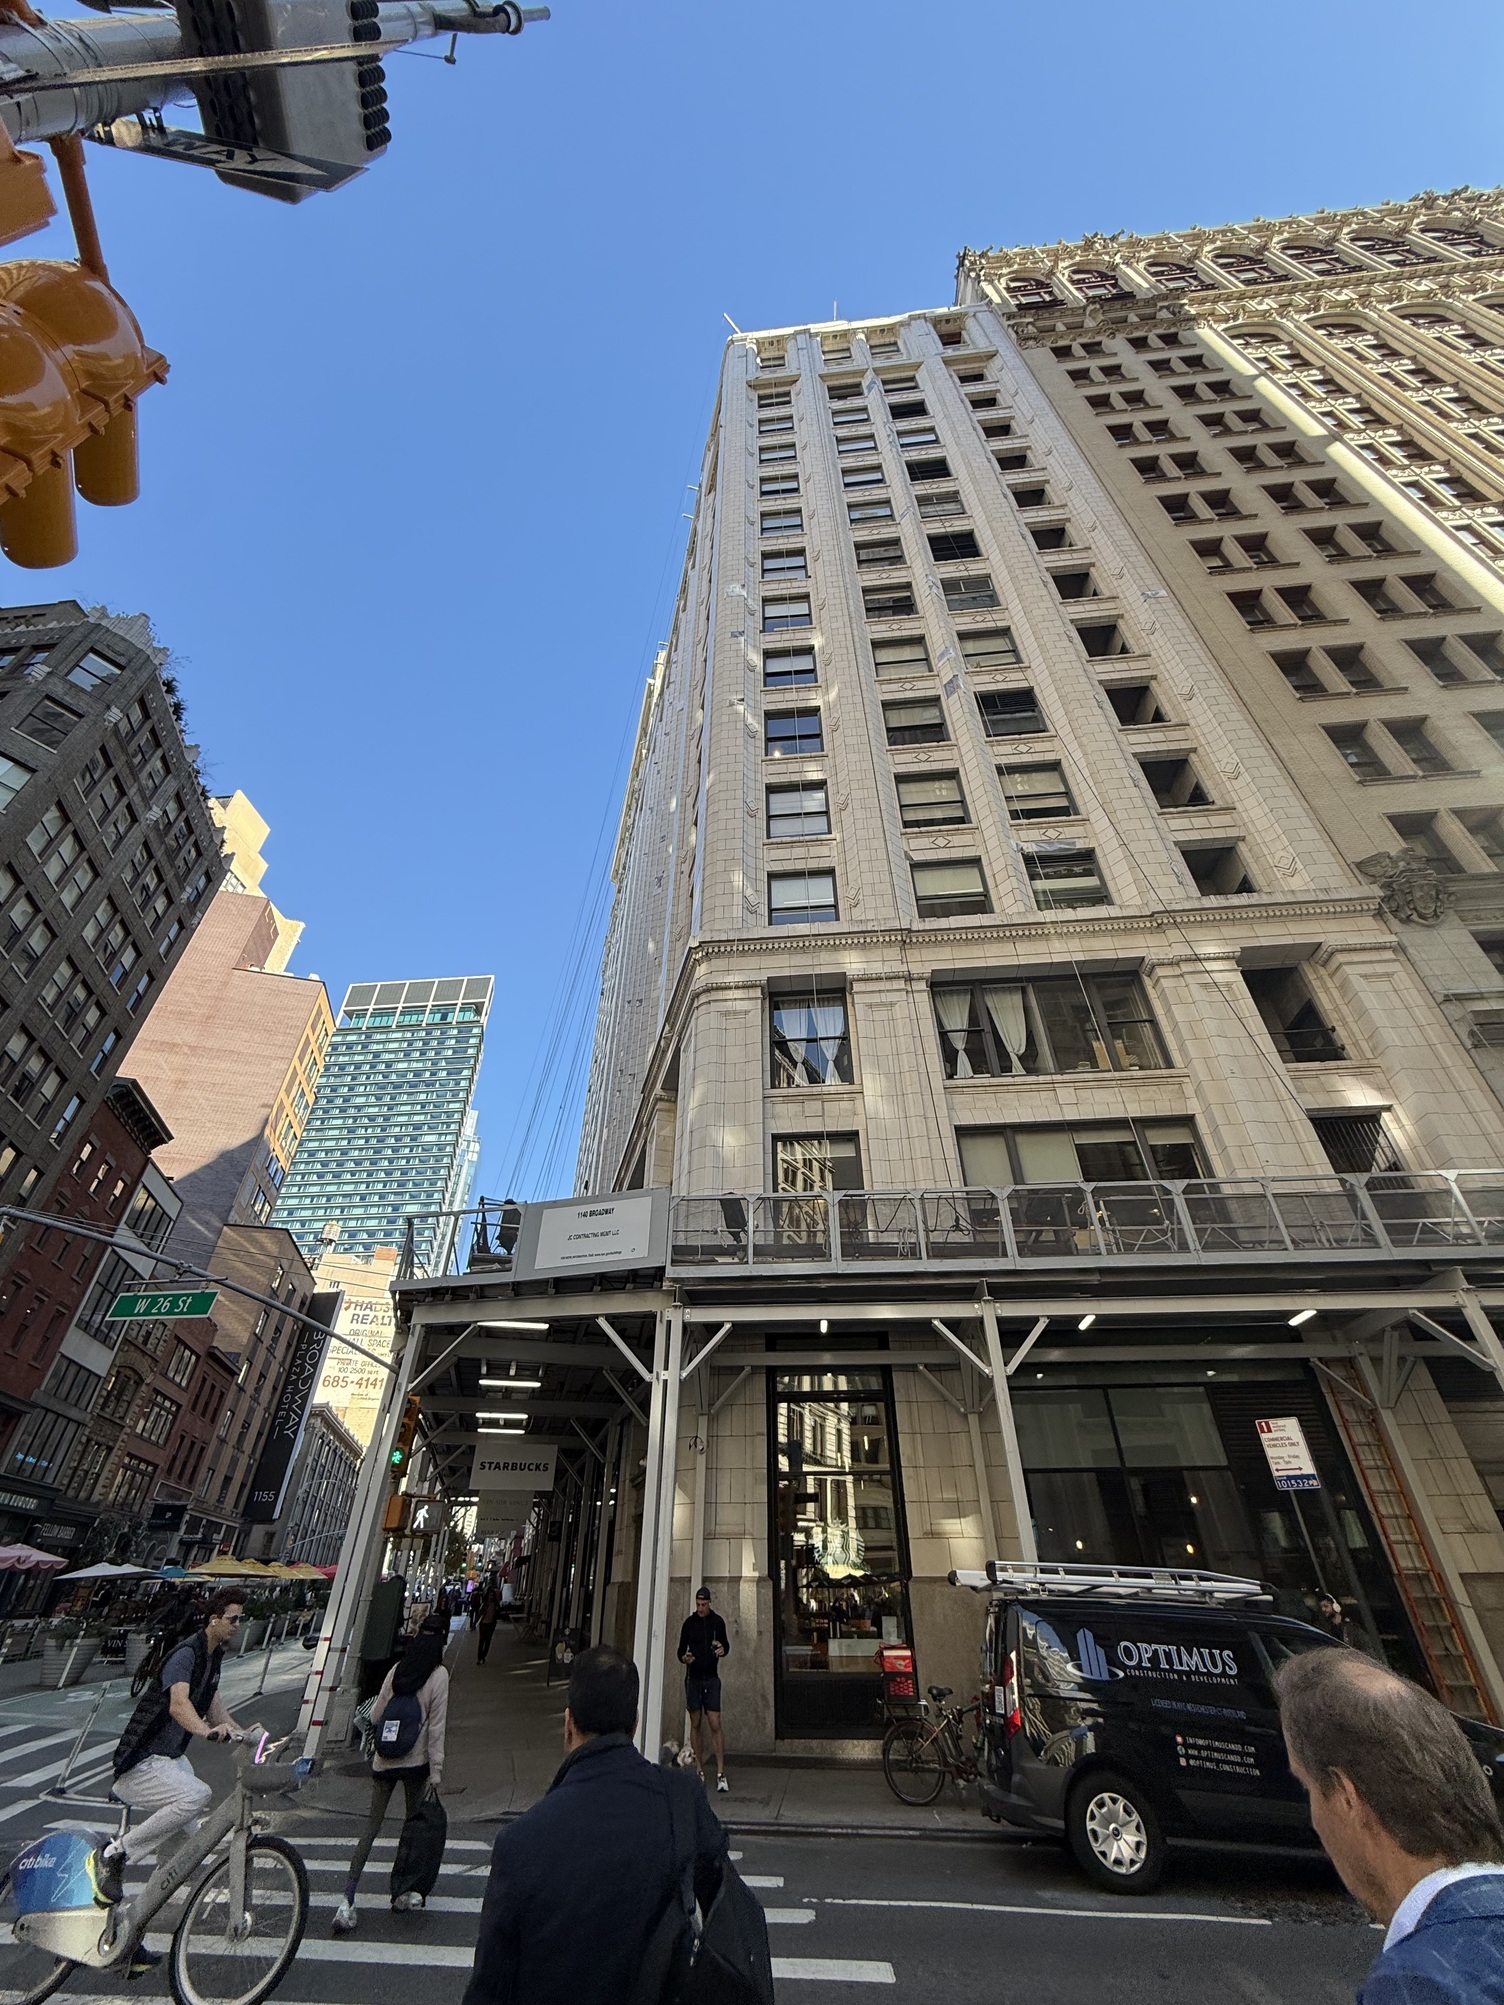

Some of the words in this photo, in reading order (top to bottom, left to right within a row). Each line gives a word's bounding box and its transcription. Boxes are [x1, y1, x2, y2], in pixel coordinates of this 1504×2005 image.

[577, 1210, 588, 1219] 1140
[588, 1207, 615, 1218] BROADWAY
[573, 1231, 600, 1241] CONTRACTING
[133, 1297, 152, 1314] W
[151, 1297, 173, 1313] 26
[173, 1295, 193, 1313] St
[350, 1313, 393, 1327] REALT
[289, 1343, 308, 1381] PLAZA
[284, 1330, 326, 1440] BROADWAY
[322, 1375, 385, 1390] 685-4141
[274, 1385, 294, 1428] HOTEL
[1261, 1421, 1268, 1433] 1
[1264, 1435, 1293, 1443] COMMERCIAL
[479, 1461, 550, 1472] STARBUCKS
[1277, 1479, 1309, 1489] 101532
[253, 1490, 276, 1502] 1155
[107, 1639, 124, 1648] VIN
[1117, 1640, 1238, 1675] OPTIMUS
[1126, 1668, 1179, 1680] CONSTRUCTION
[1191, 1674, 1239, 1686] DEVELOPMENT
[1189, 1759, 1261, 1777] @OPTIMUS_CONSTRUCTION
